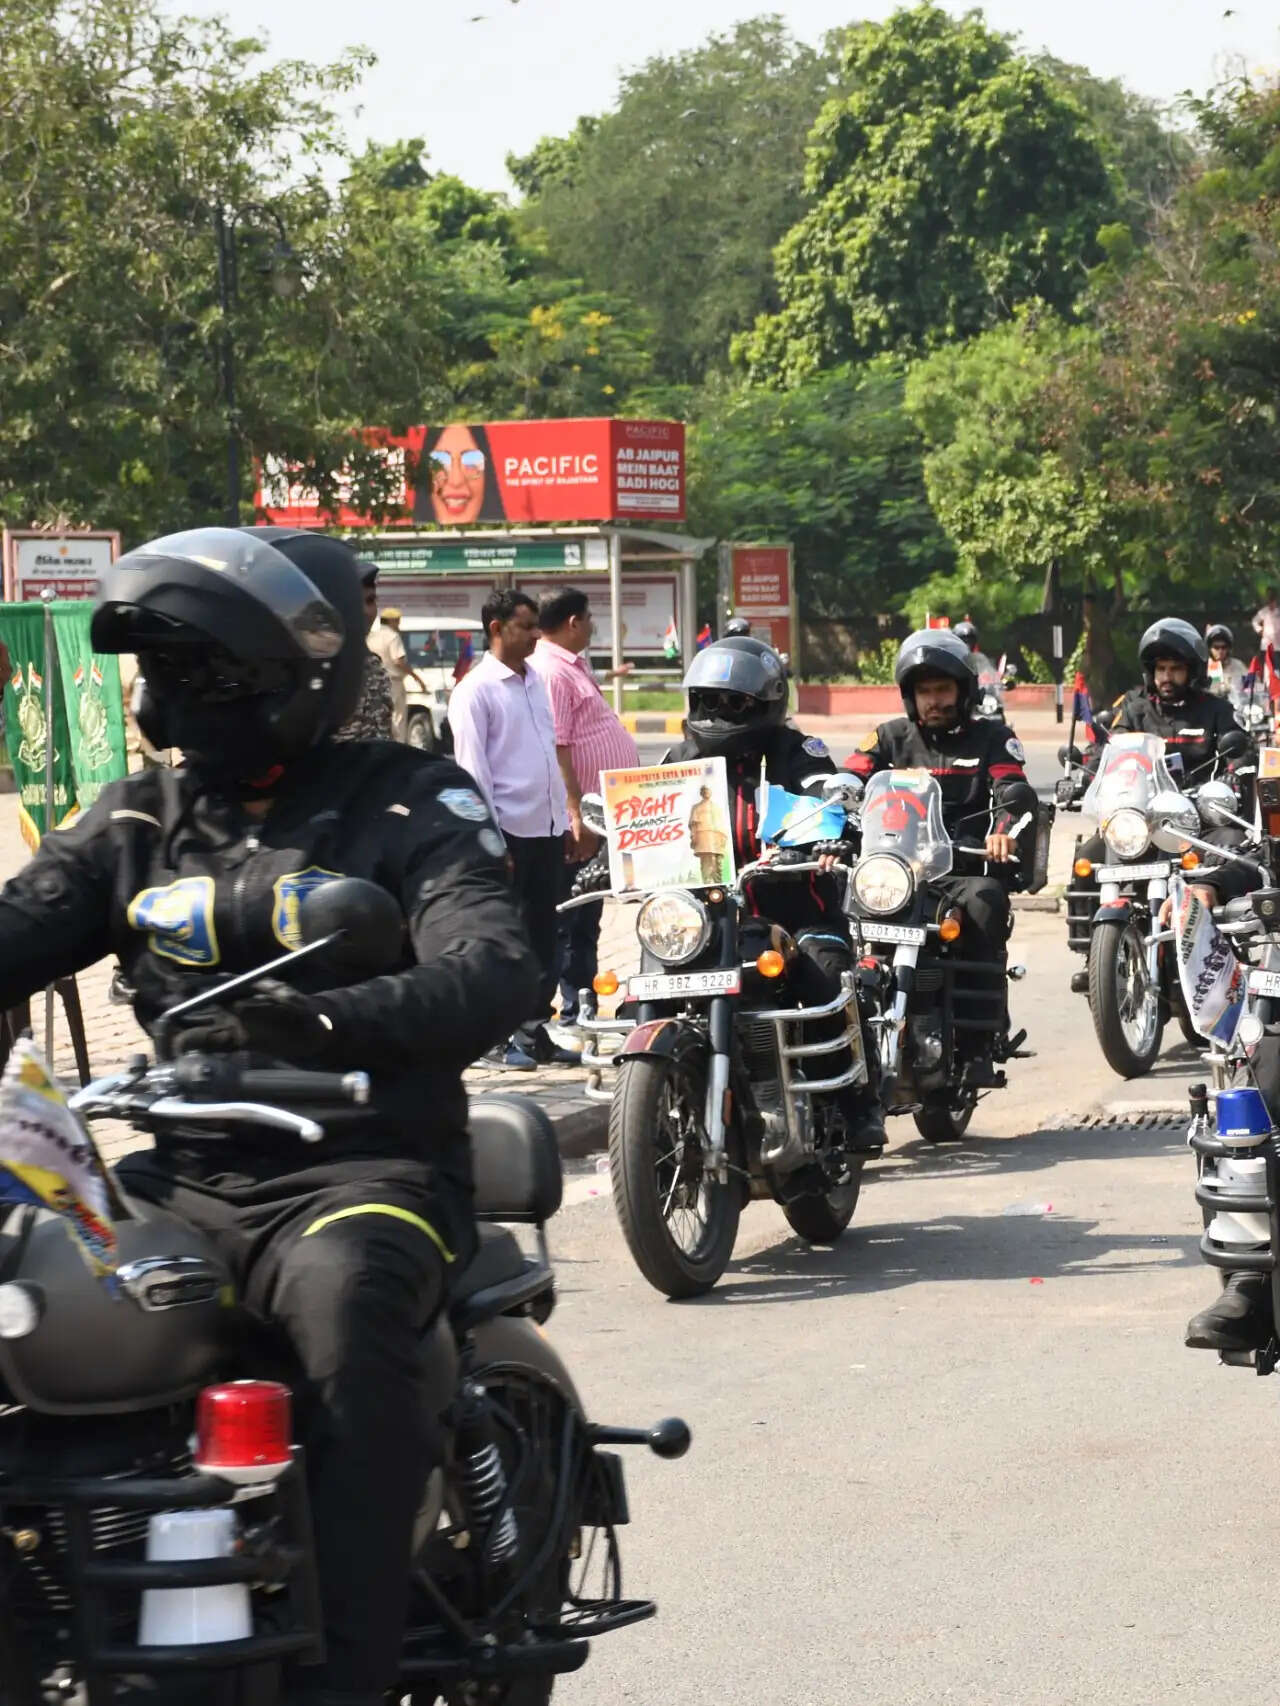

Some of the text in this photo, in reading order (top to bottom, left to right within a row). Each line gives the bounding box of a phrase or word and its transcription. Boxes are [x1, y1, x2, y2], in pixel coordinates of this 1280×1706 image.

[616, 448, 680, 462] AB JAIPUR
[504, 454, 599, 476] PACIFIC
[616, 462, 680, 476] MEIN BAAT
[617, 476, 680, 490] BADI HOGI
[613, 792, 683, 825] FIGHT
[629, 816, 668, 829] AGAINST
[616, 823, 685, 850] DRUGS
[644, 980, 658, 993] HR
[1265, 974, 1280, 989] HR
